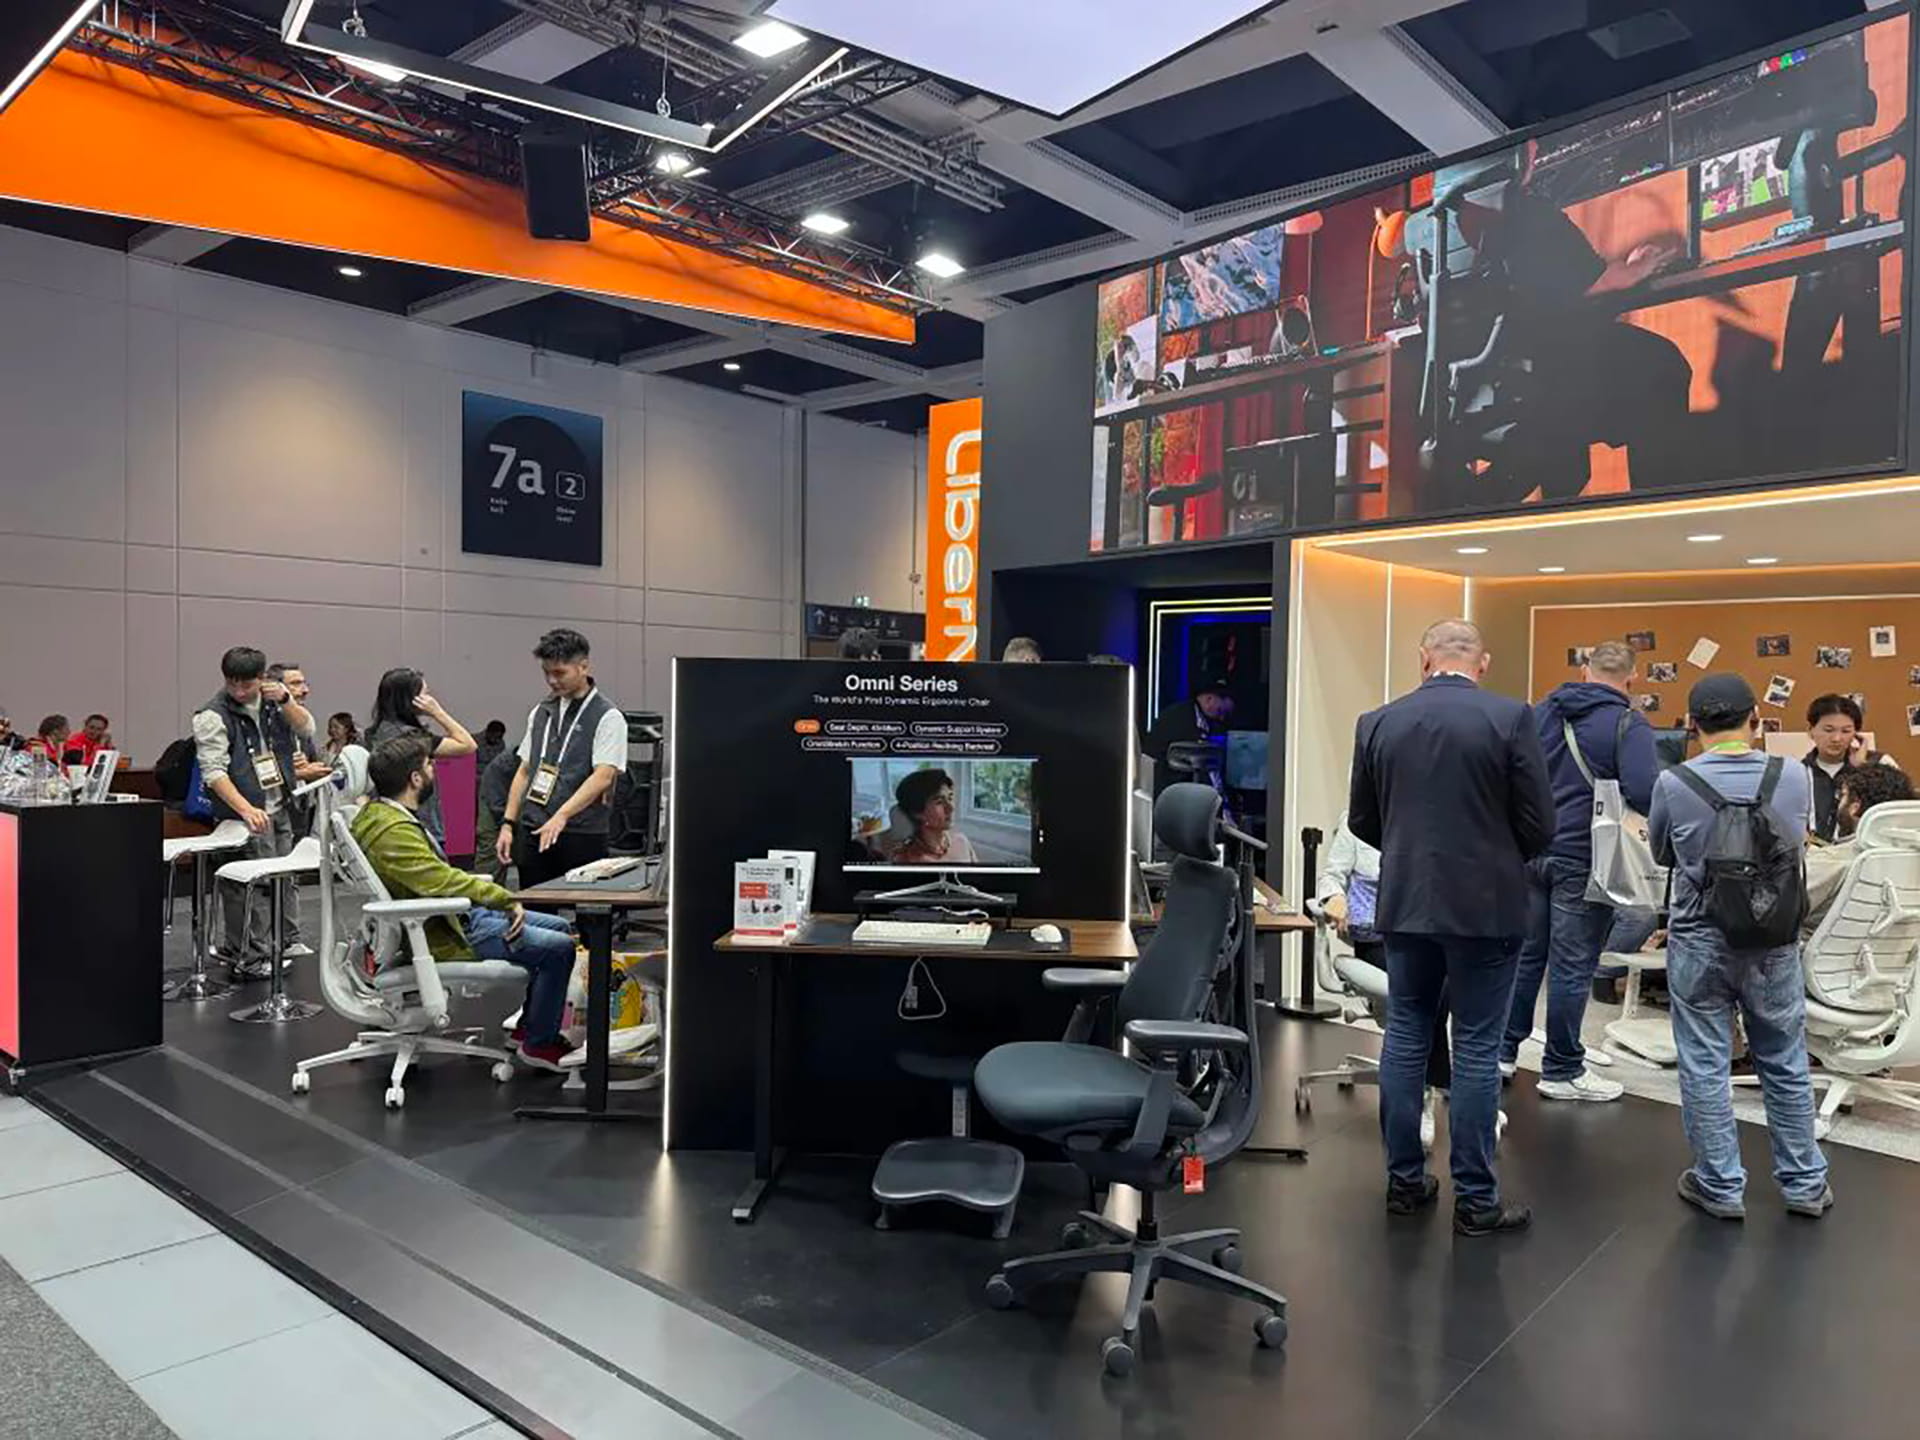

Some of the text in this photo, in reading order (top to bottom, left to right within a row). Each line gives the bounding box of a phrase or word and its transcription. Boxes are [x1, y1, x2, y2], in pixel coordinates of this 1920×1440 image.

[489, 443, 577, 495] 7a 2
[845, 674, 959, 692] Omni Series
[813, 695, 829, 704] The
[864, 696, 882, 705] First
[884, 696, 920, 707] Dynamic
[968, 698, 991, 706] Chair
[947, 725, 974, 735] Support
